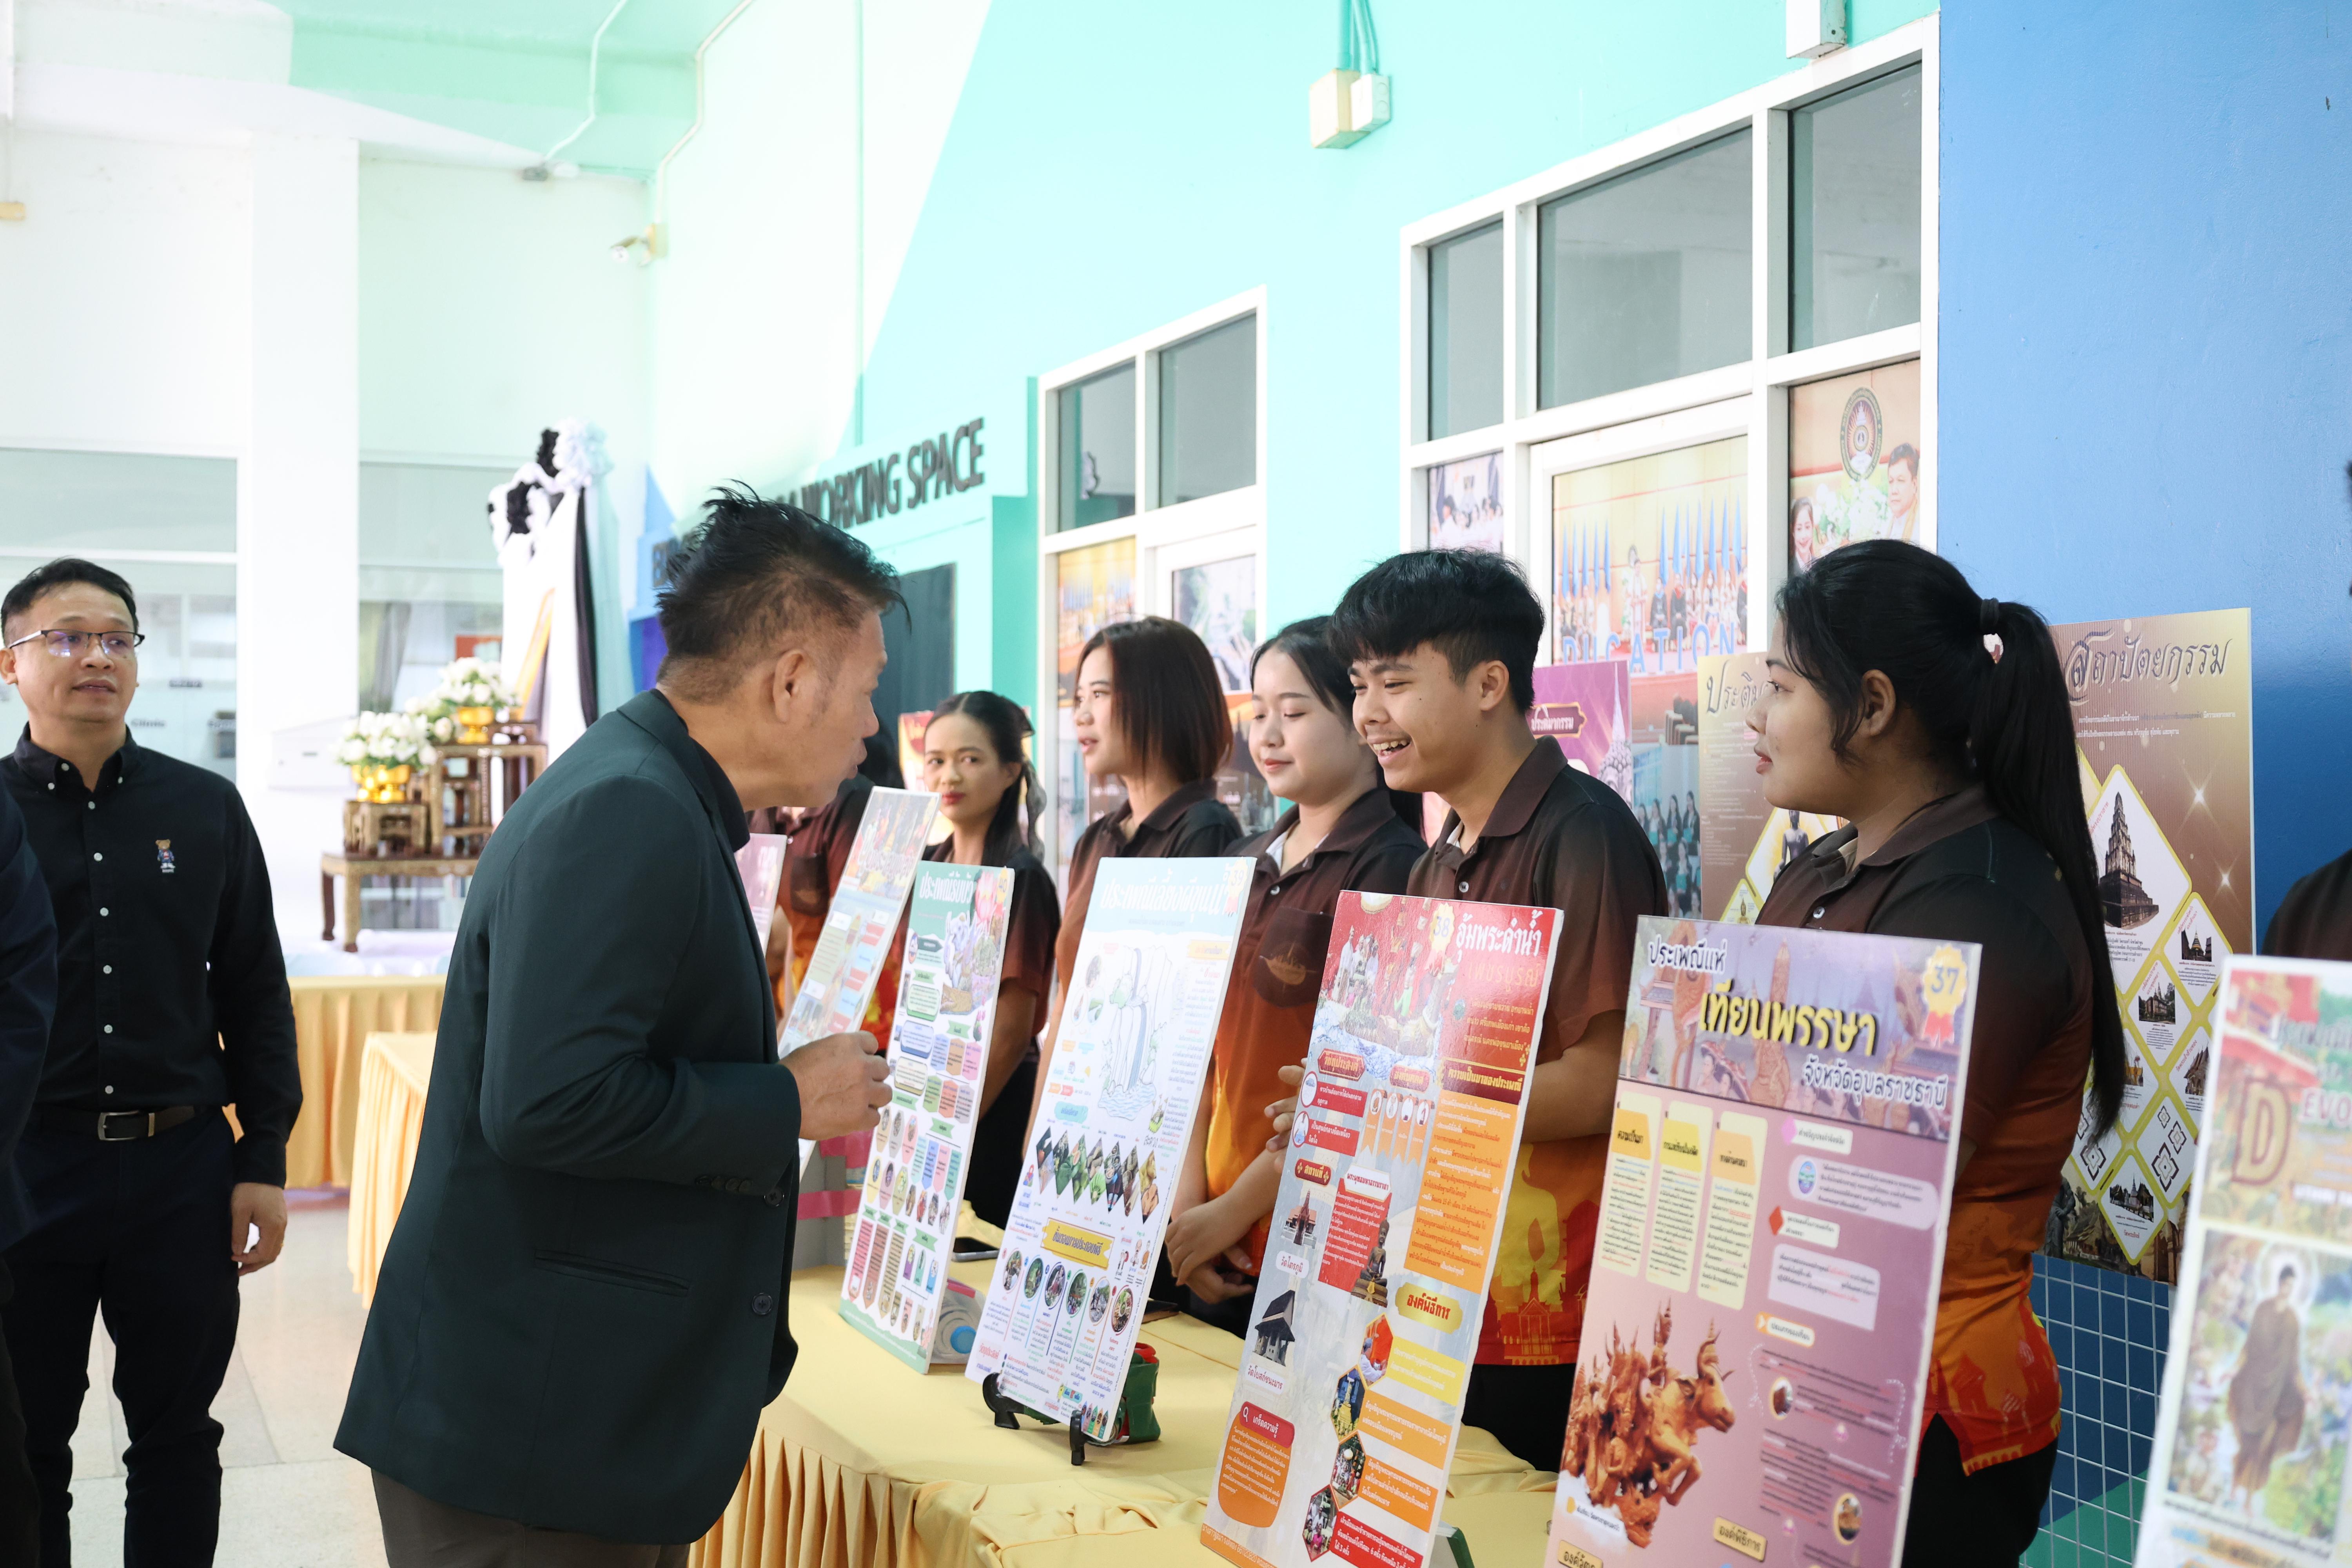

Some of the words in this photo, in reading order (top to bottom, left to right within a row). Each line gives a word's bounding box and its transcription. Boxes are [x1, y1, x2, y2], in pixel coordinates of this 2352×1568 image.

[907, 416, 985, 509] SPACE
[2065, 628, 2233, 702] สถาปัตยกรรม
[1530, 706, 1574, 731] ประติมากรรม
[919, 871, 975, 904] ประเพณีรับบัว
[1230, 869, 1244, 886] 39
[1433, 916, 1450, 937] 38
[1456, 909, 1542, 963] อุ้มพระดำน้ำ
[1648, 936, 1727, 973] ประเพณีแห่
[1931, 965, 1958, 995] 37
[1698, 980, 1879, 1057] เทียนพรรษา
[1448, 1066, 1523, 1092] ความเป็นมาของประเพณี
[1803, 1054, 1948, 1108] จังหวัดอุบลราชธานี
[1304, 1165, 1325, 1179] สถานที่
[1052, 1226, 1103, 1256] ขั้นตอนการประกอบพิธี
[1281, 1256, 1303, 1275] วัดไตรภูมิ
[1406, 1292, 1451, 1320] องค์พิธีการ
[1252, 1414, 1279, 1439] เกร็ดความรู้
[1718, 1526, 1761, 1553] องค์พิธีการ
